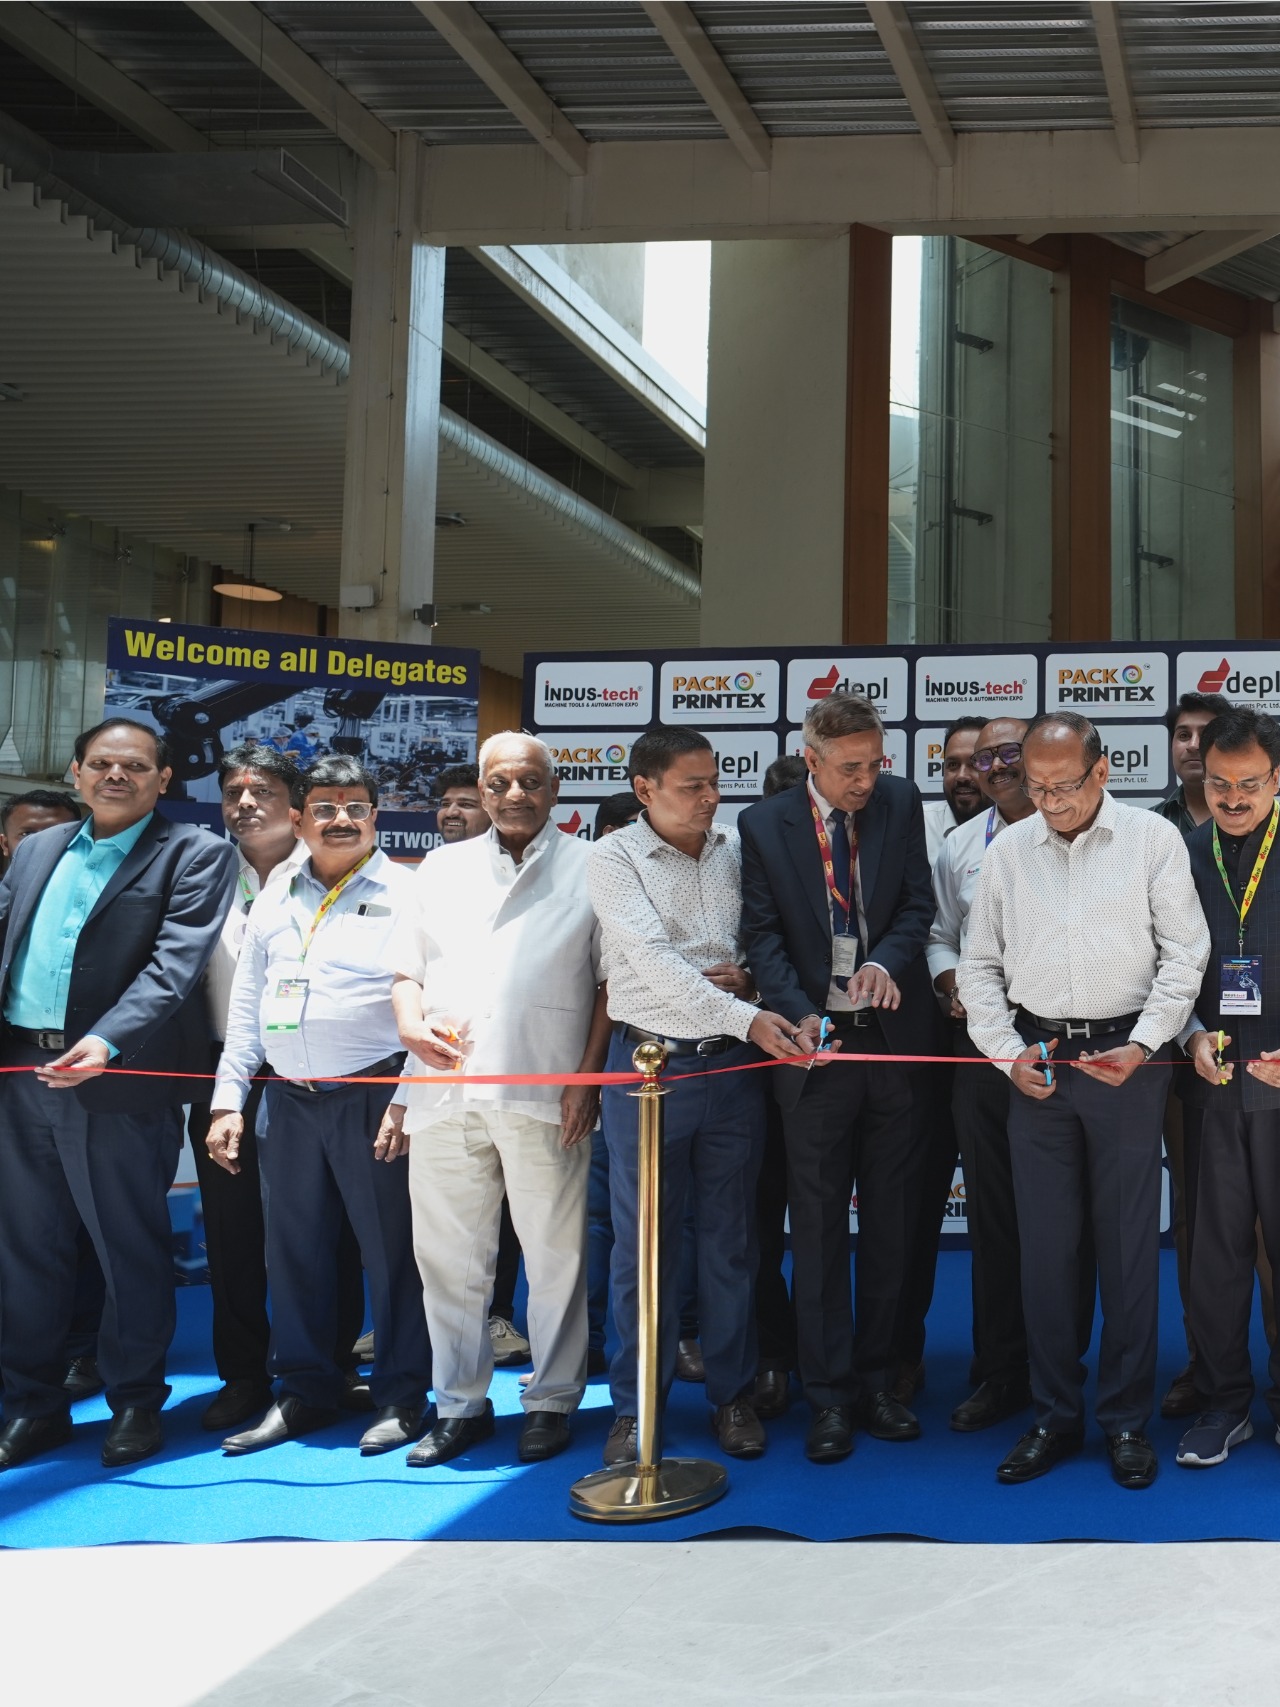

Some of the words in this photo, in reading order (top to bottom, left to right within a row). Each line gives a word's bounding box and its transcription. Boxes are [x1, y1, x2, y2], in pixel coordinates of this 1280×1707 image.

[125, 629, 270, 670] Welcome
[280, 648, 317, 673] all
[327, 650, 467, 686] Delegates
[672, 676, 731, 692] PACK
[1058, 668, 1119, 684] PACK
[1226, 670, 1280, 699] depl
[672, 693, 766, 709] PRINTEX
[1058, 686, 1155, 703] PRINTEX
[554, 766, 630, 781] RINTE
[374, 831, 445, 849] ETWOR
